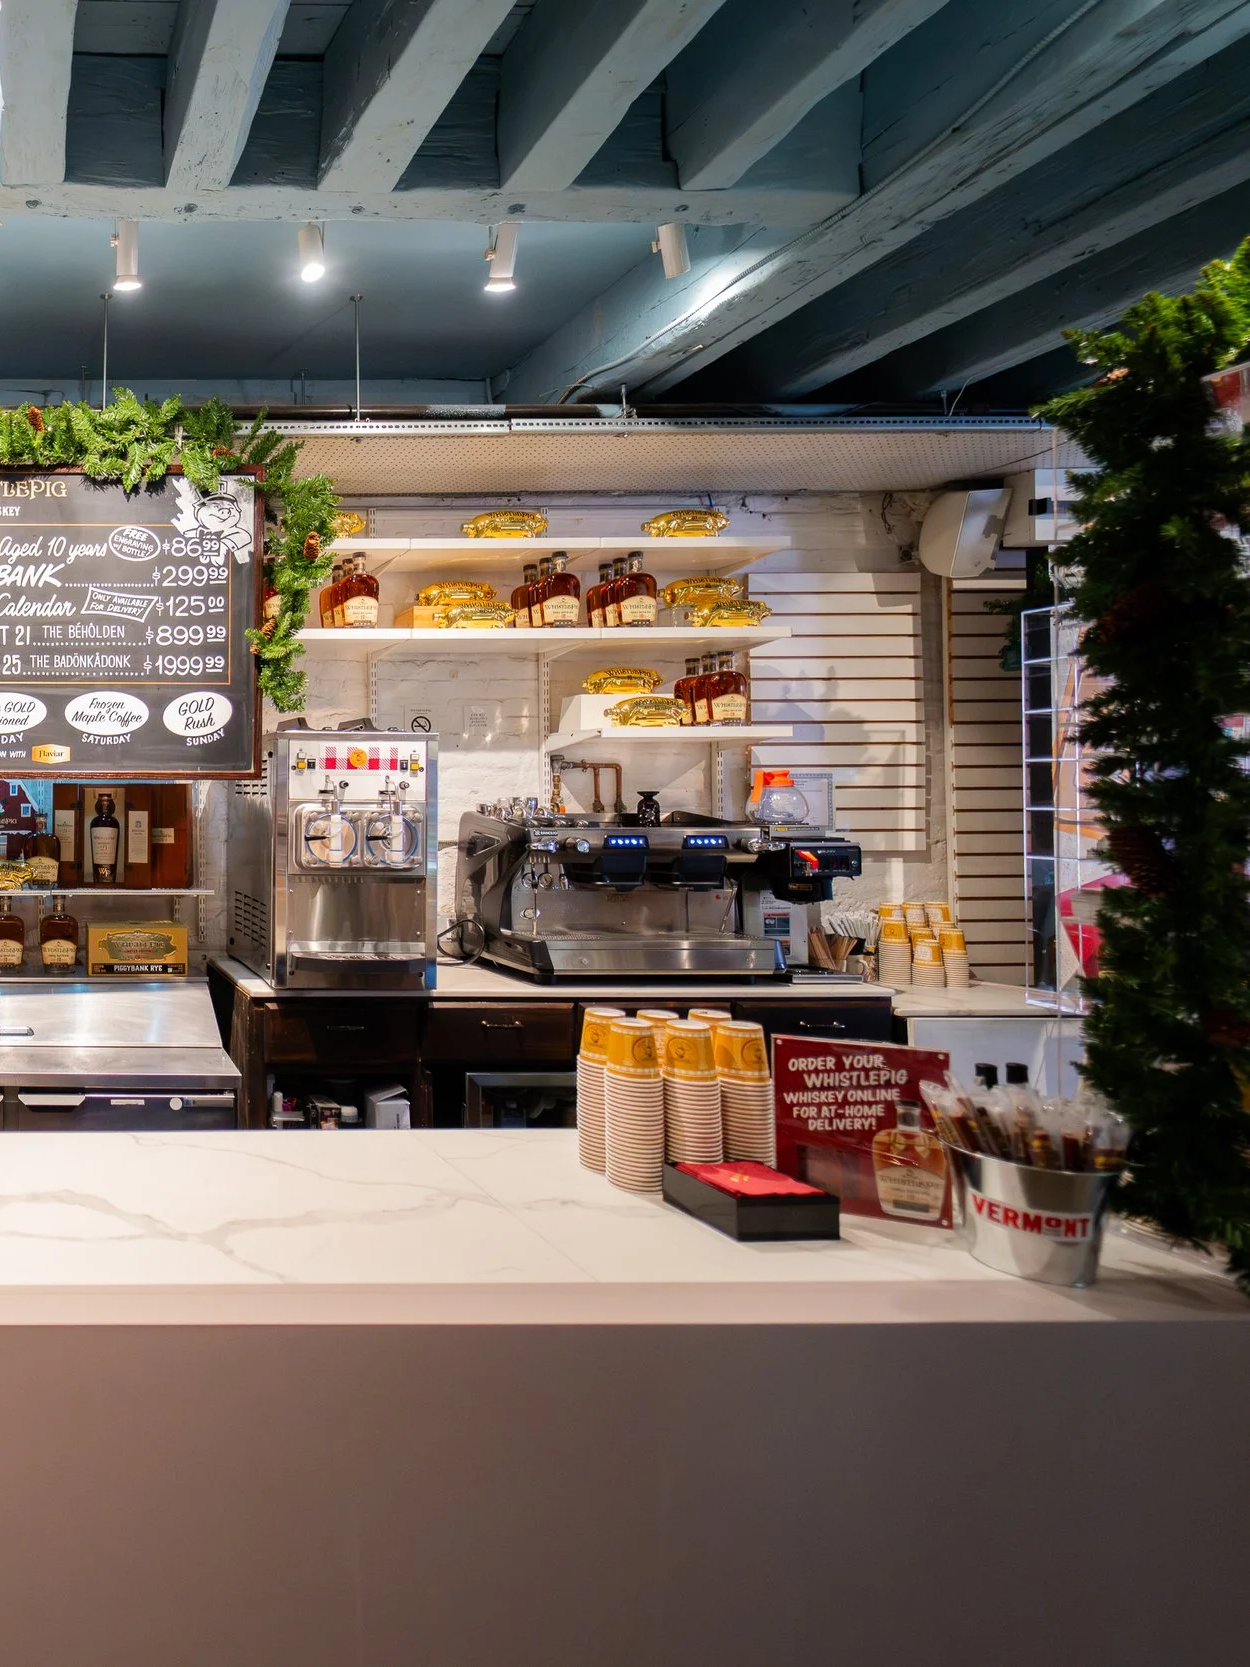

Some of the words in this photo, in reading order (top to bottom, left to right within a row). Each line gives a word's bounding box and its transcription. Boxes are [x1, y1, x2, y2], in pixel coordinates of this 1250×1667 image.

[123, 529, 149, 541] FREE
[47, 537, 67, 557] 10
[68, 541, 107, 564] years
[114, 535, 154, 552] ENGRAVING
[122, 546, 150, 558] BOTTLE!
[92, 592, 111, 601] ONLY
[112, 596, 149, 608] AVAILABLE
[90, 602, 105, 612] FOR
[107, 604, 144, 616] DELIVERY
[15, 626, 31, 646] 21
[42, 625, 63, 639] THE
[2, 655, 22, 675] 25
[30, 655, 50, 669] THE
[3, 701, 36, 713] GOLD
[88, 697, 126, 713] Frozen
[178, 697, 215, 716] GOLD
[71, 711, 106, 725] Maple
[108, 711, 142, 727] Coffee
[184, 716, 215, 731] Rush
[81, 733, 132, 745] SATURDAY
[185, 729, 226, 747] SUNDAY
[9, 751, 26, 759] WITH
[150, 964, 163, 972] RYE
[788, 1056, 836, 1072] ORDER
[843, 1054, 884, 1070] YOUR
[803, 1070, 908, 1088] WHISTLEPIG
[783, 1091, 845, 1105] WHISKEY
[847, 1088, 901, 1102] ONLINE
[792, 1106, 818, 1119] FOR
[821, 1104, 886, 1118] AT-HOME
[808, 1117, 877, 1131] DELIVERY!
[972, 1193, 1090, 1238] VERMONT
